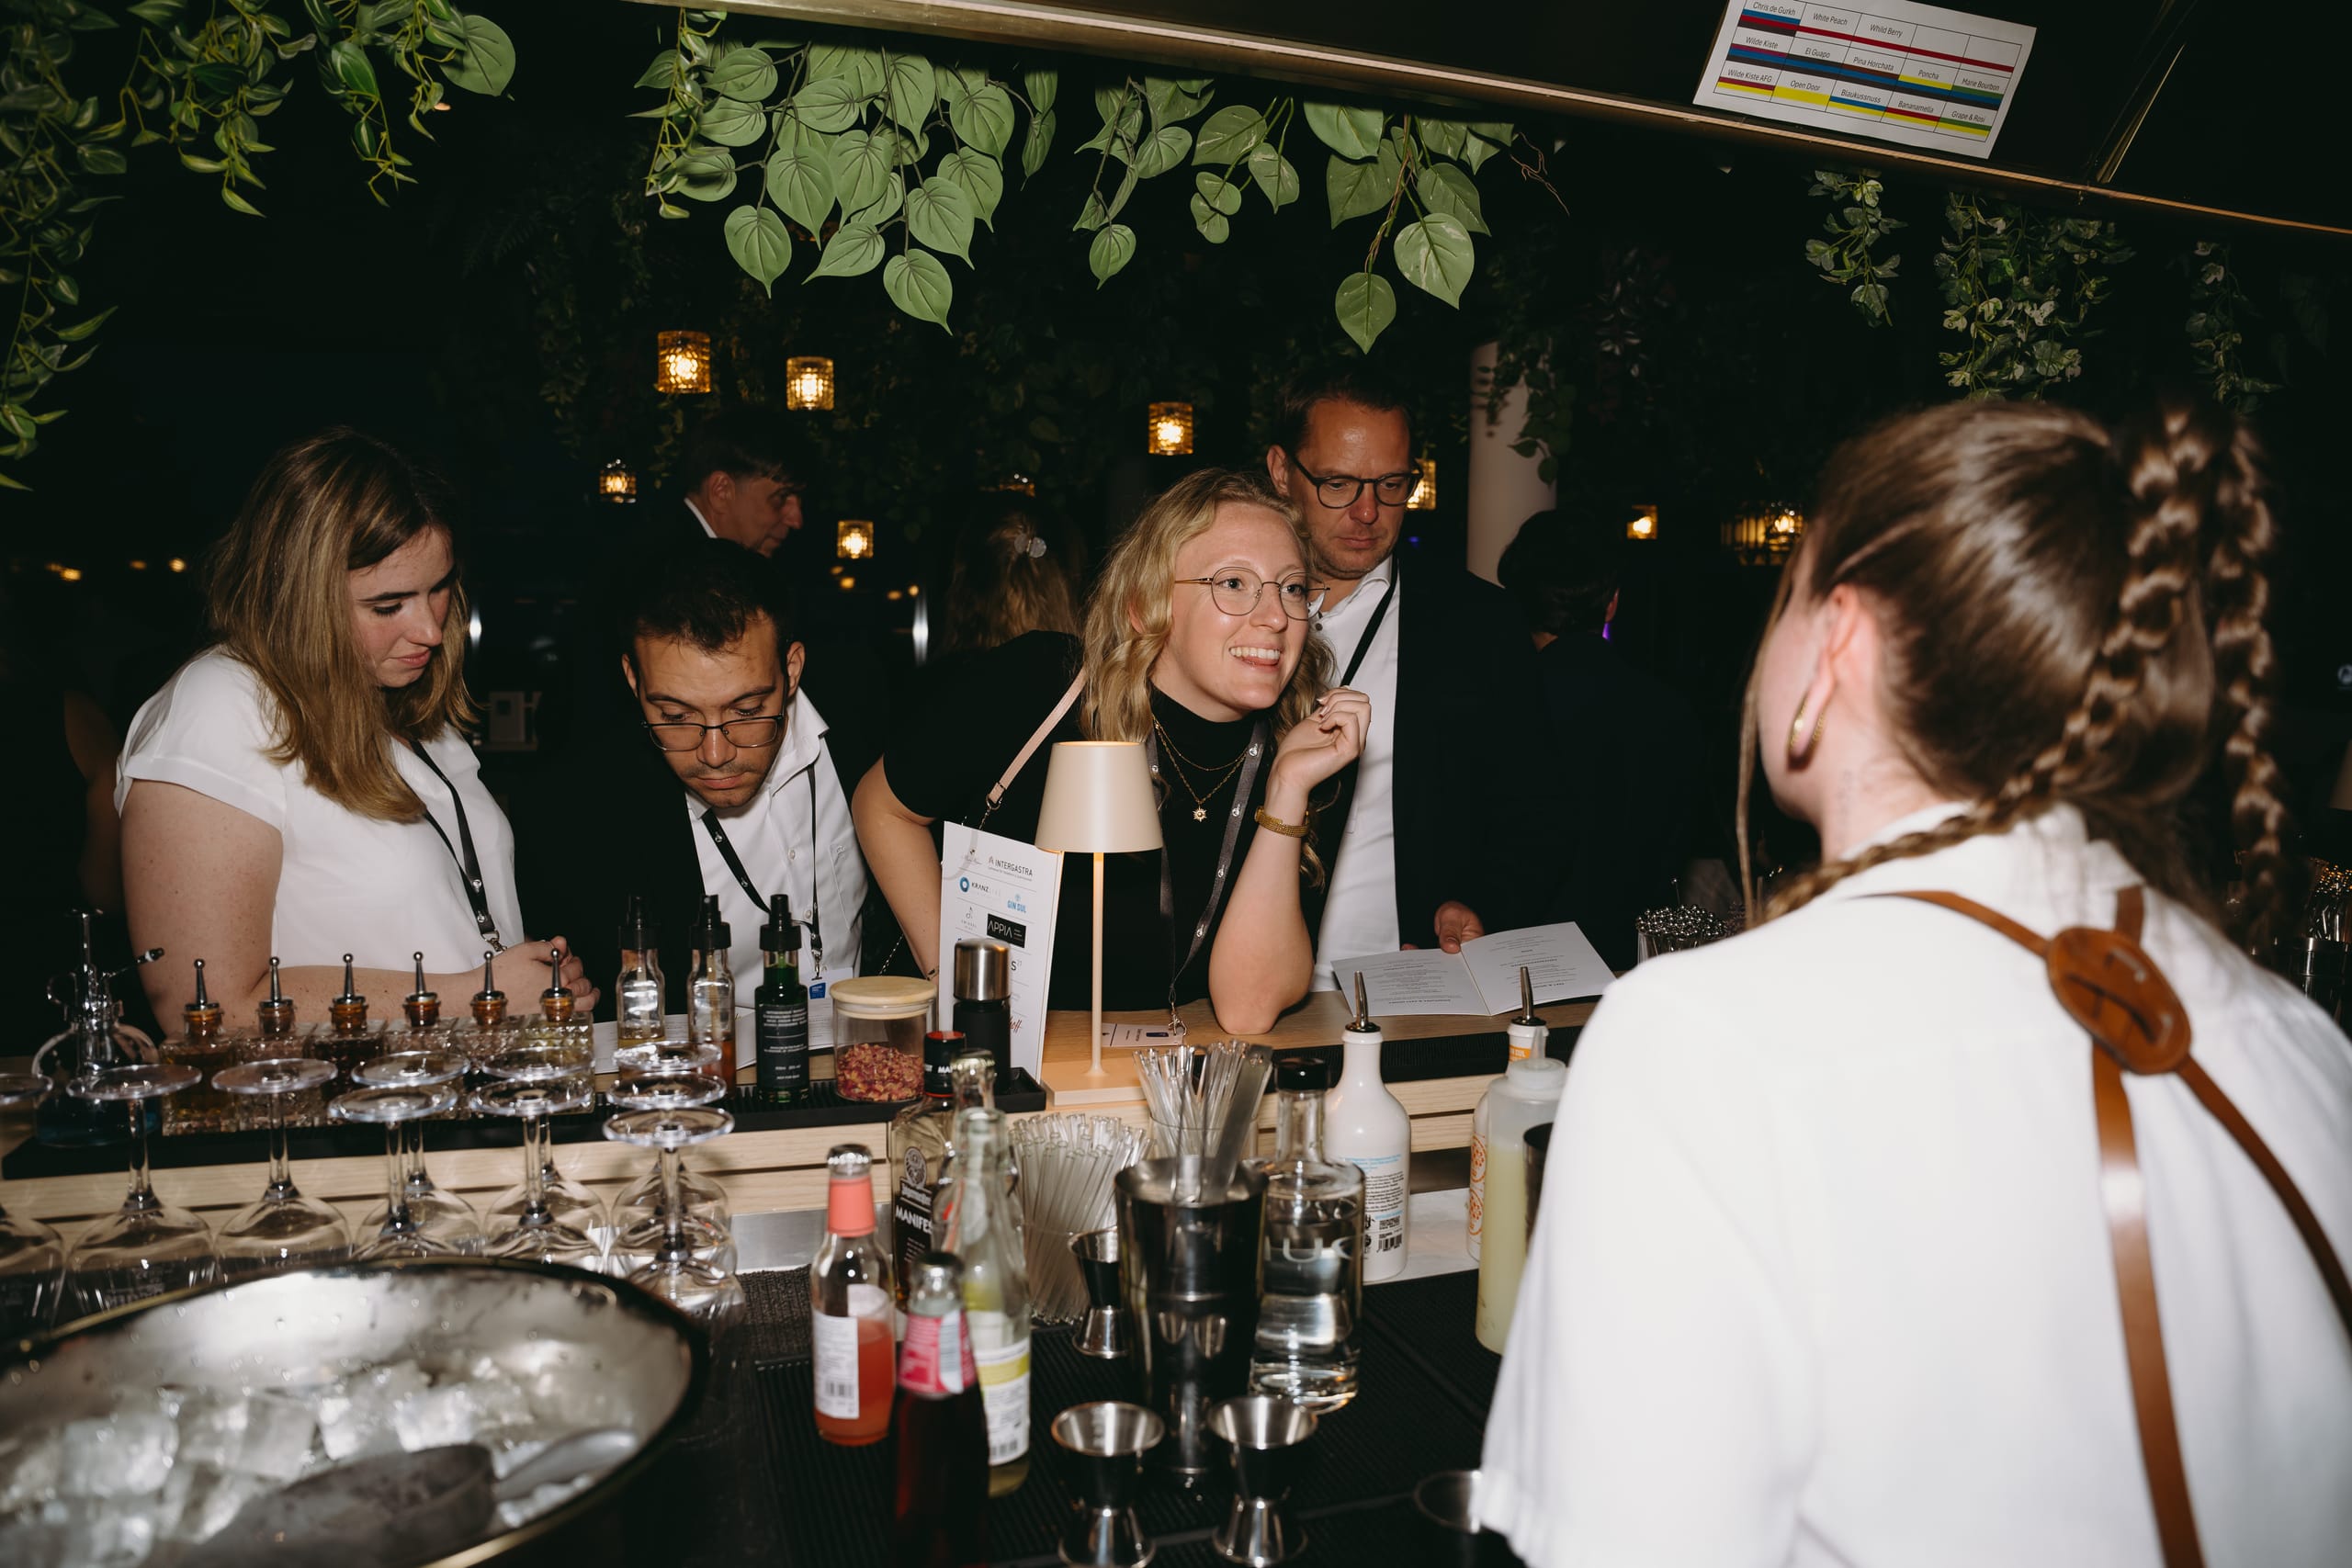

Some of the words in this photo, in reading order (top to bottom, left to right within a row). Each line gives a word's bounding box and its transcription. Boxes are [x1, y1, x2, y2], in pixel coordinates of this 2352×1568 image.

[1752, 1, 1769, 11] Chris
[1813, 12, 1829, 22] White
[1829, 16, 1848, 26] Peach
[1887, 27, 1904, 38] Berry
[1746, 36, 1763, 46] Wilde
[1763, 39, 1779, 49] Kiste
[1804, 47, 1811, 55] El
[1811, 48, 1831, 59] Guapo
[1867, 59, 1894, 72] Horchata
[1727, 68, 1744, 78] Wilde
[1744, 72, 1759, 81] Kiste
[1759, 73, 1773, 83] AFG
[1917, 69, 1939, 80] Poncha
[1790, 80, 1806, 89] Open
[1806, 82, 1821, 91] Door
[1977, 80, 2000, 91] Bourbon
[1840, 88, 1882, 104] Blaukussnuss
[1951, 110, 1968, 120] Grape
[995, 859, 1034, 876] INTERGASTRA
[1007, 899, 1016, 910] GIN
[1016, 902, 1027, 913] SUL
[988, 919, 1012, 938] APPIA
